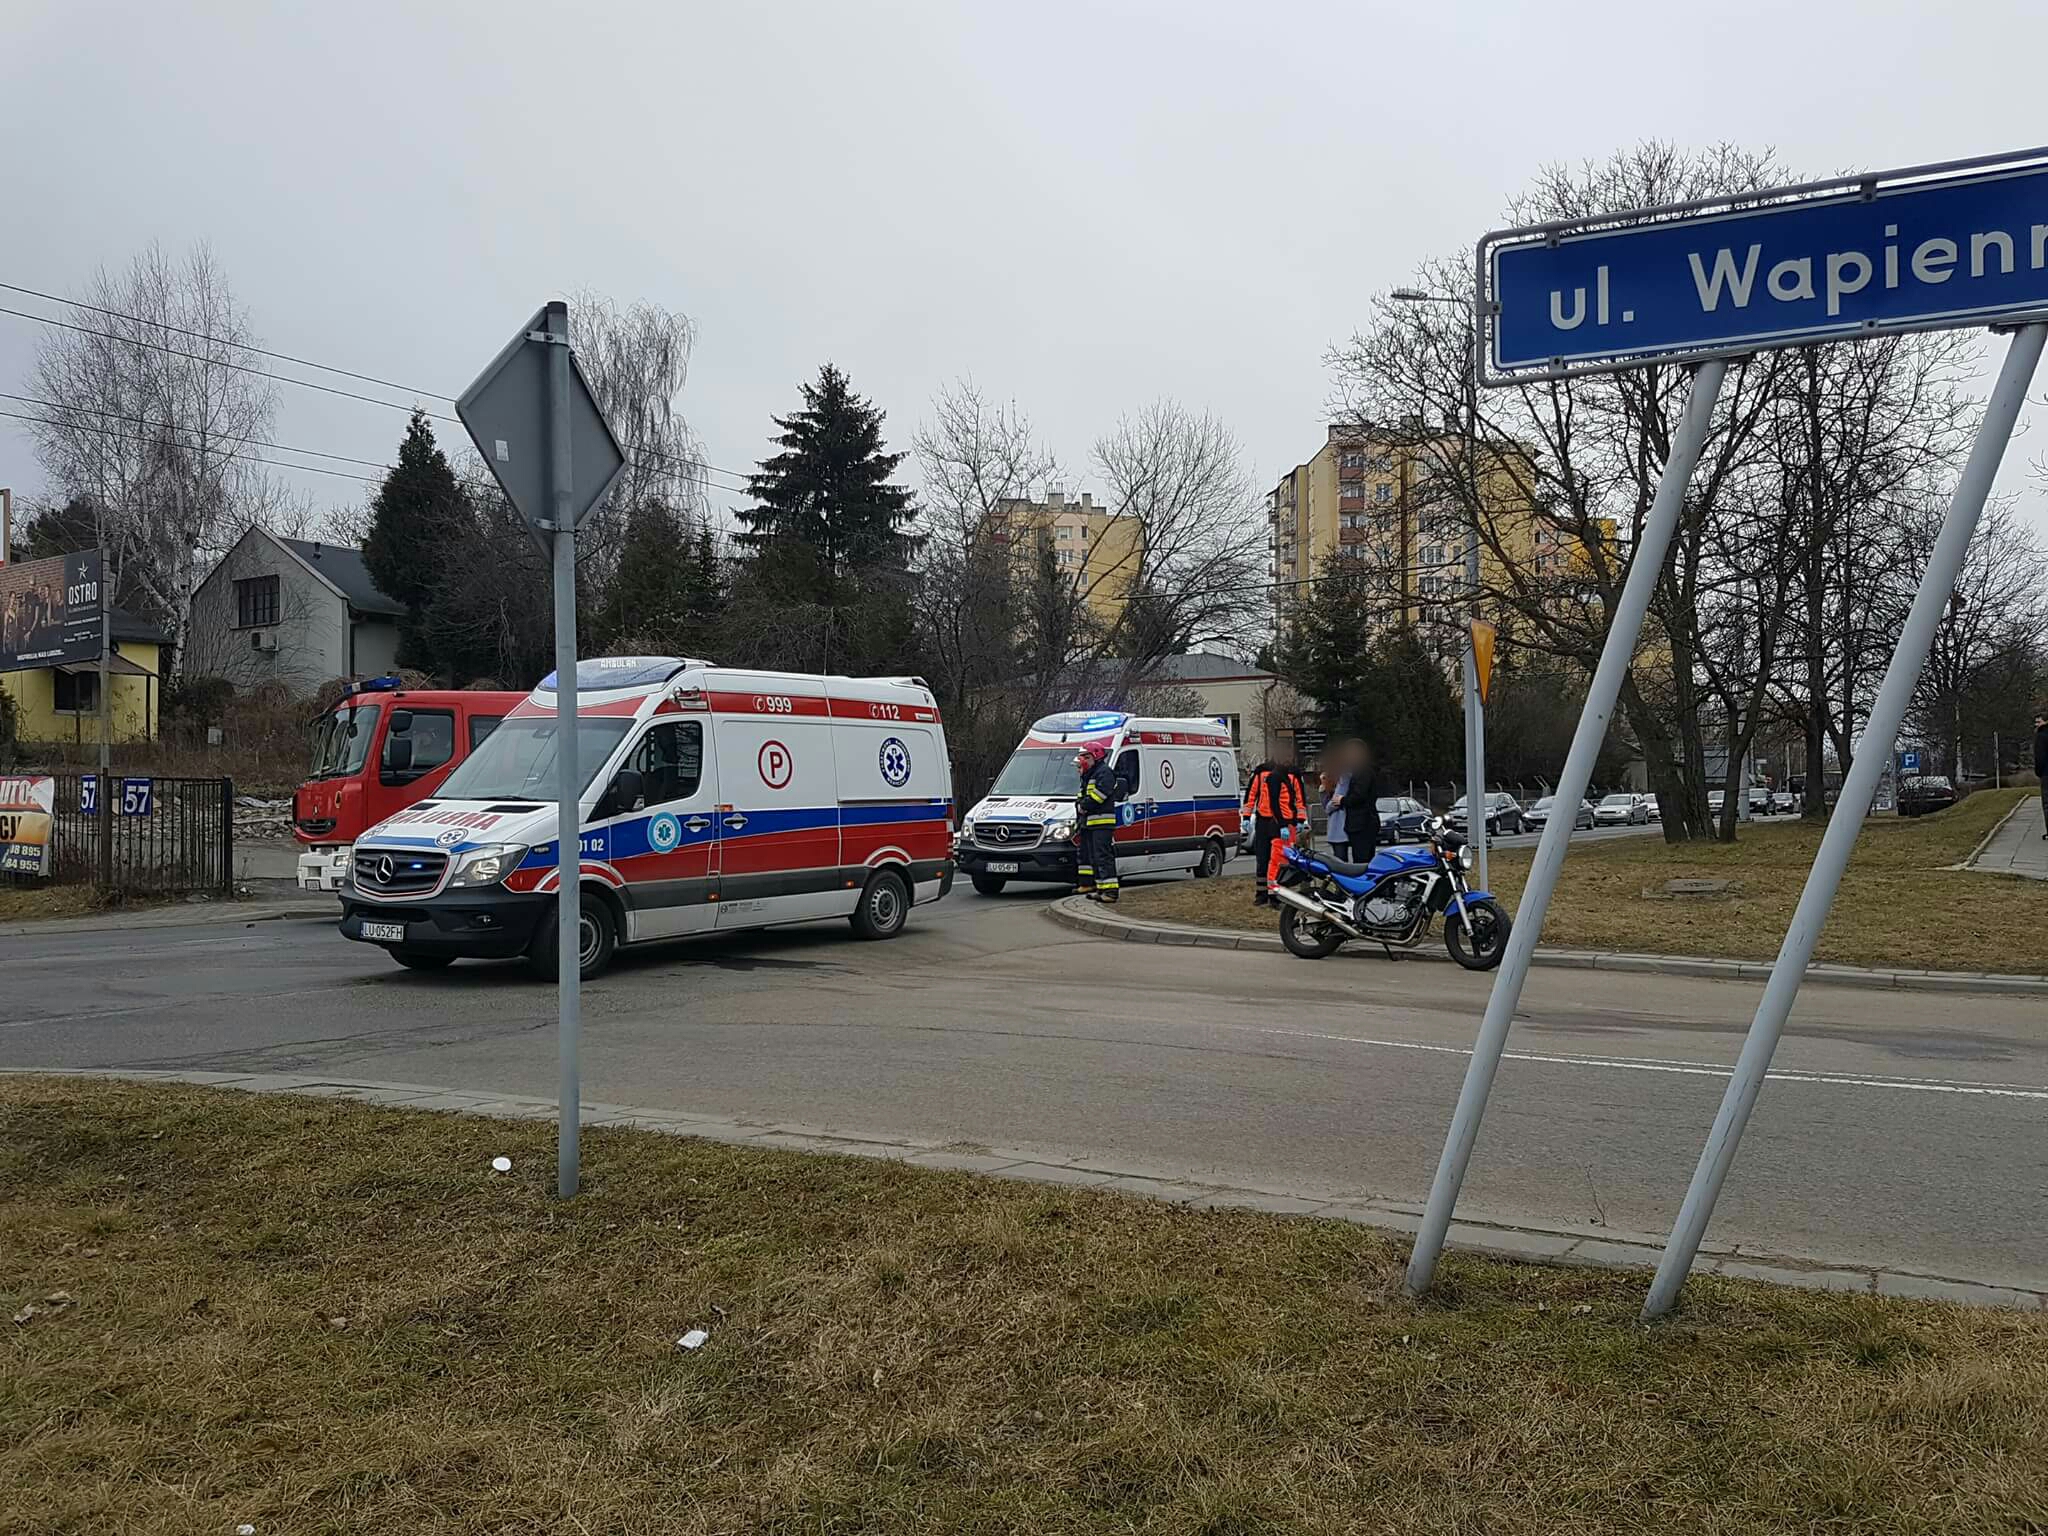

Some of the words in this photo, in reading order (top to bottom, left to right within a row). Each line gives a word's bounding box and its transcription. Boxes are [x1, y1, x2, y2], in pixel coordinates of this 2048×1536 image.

[1550, 265, 1636, 330] ul.
[68, 581, 98, 605] OSTRO
[767, 696, 793, 713] 999
[879, 704, 901, 720] 112
[769, 751, 784, 779] P
[80, 781, 97, 809] 57
[124, 785, 150, 813] 57
[21, 845, 41, 857] 895
[591, 838, 604, 852] 02
[19, 859, 40, 871] 955
